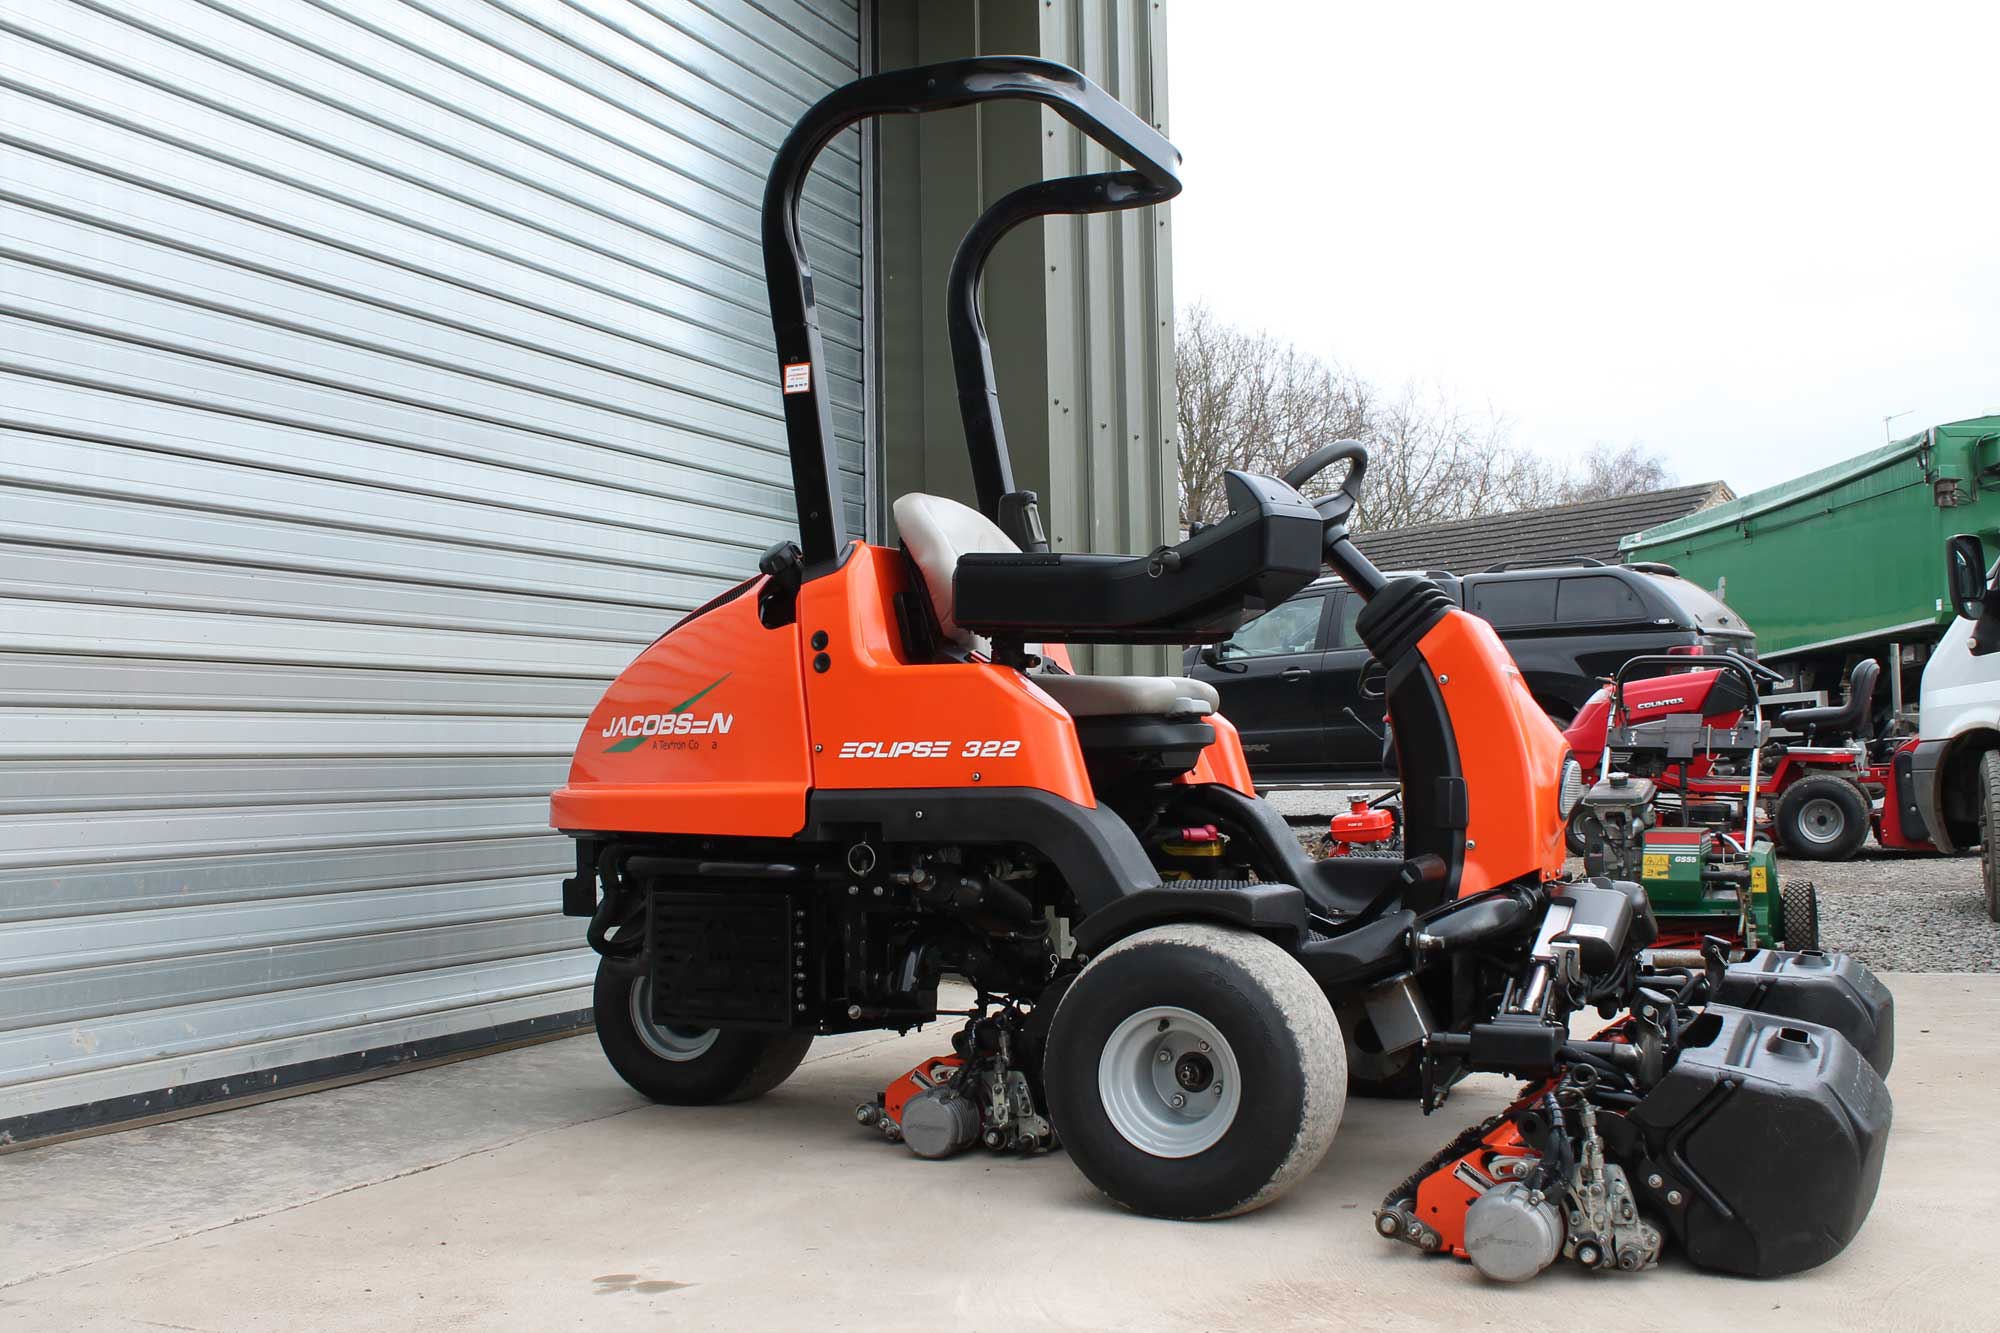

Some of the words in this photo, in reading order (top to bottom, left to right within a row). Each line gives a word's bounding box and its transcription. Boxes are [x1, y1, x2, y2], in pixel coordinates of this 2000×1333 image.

[602, 712, 734, 738] JACOBSEN
[838, 741, 952, 759] ECLIPSE
[961, 740, 1021, 758] 322
